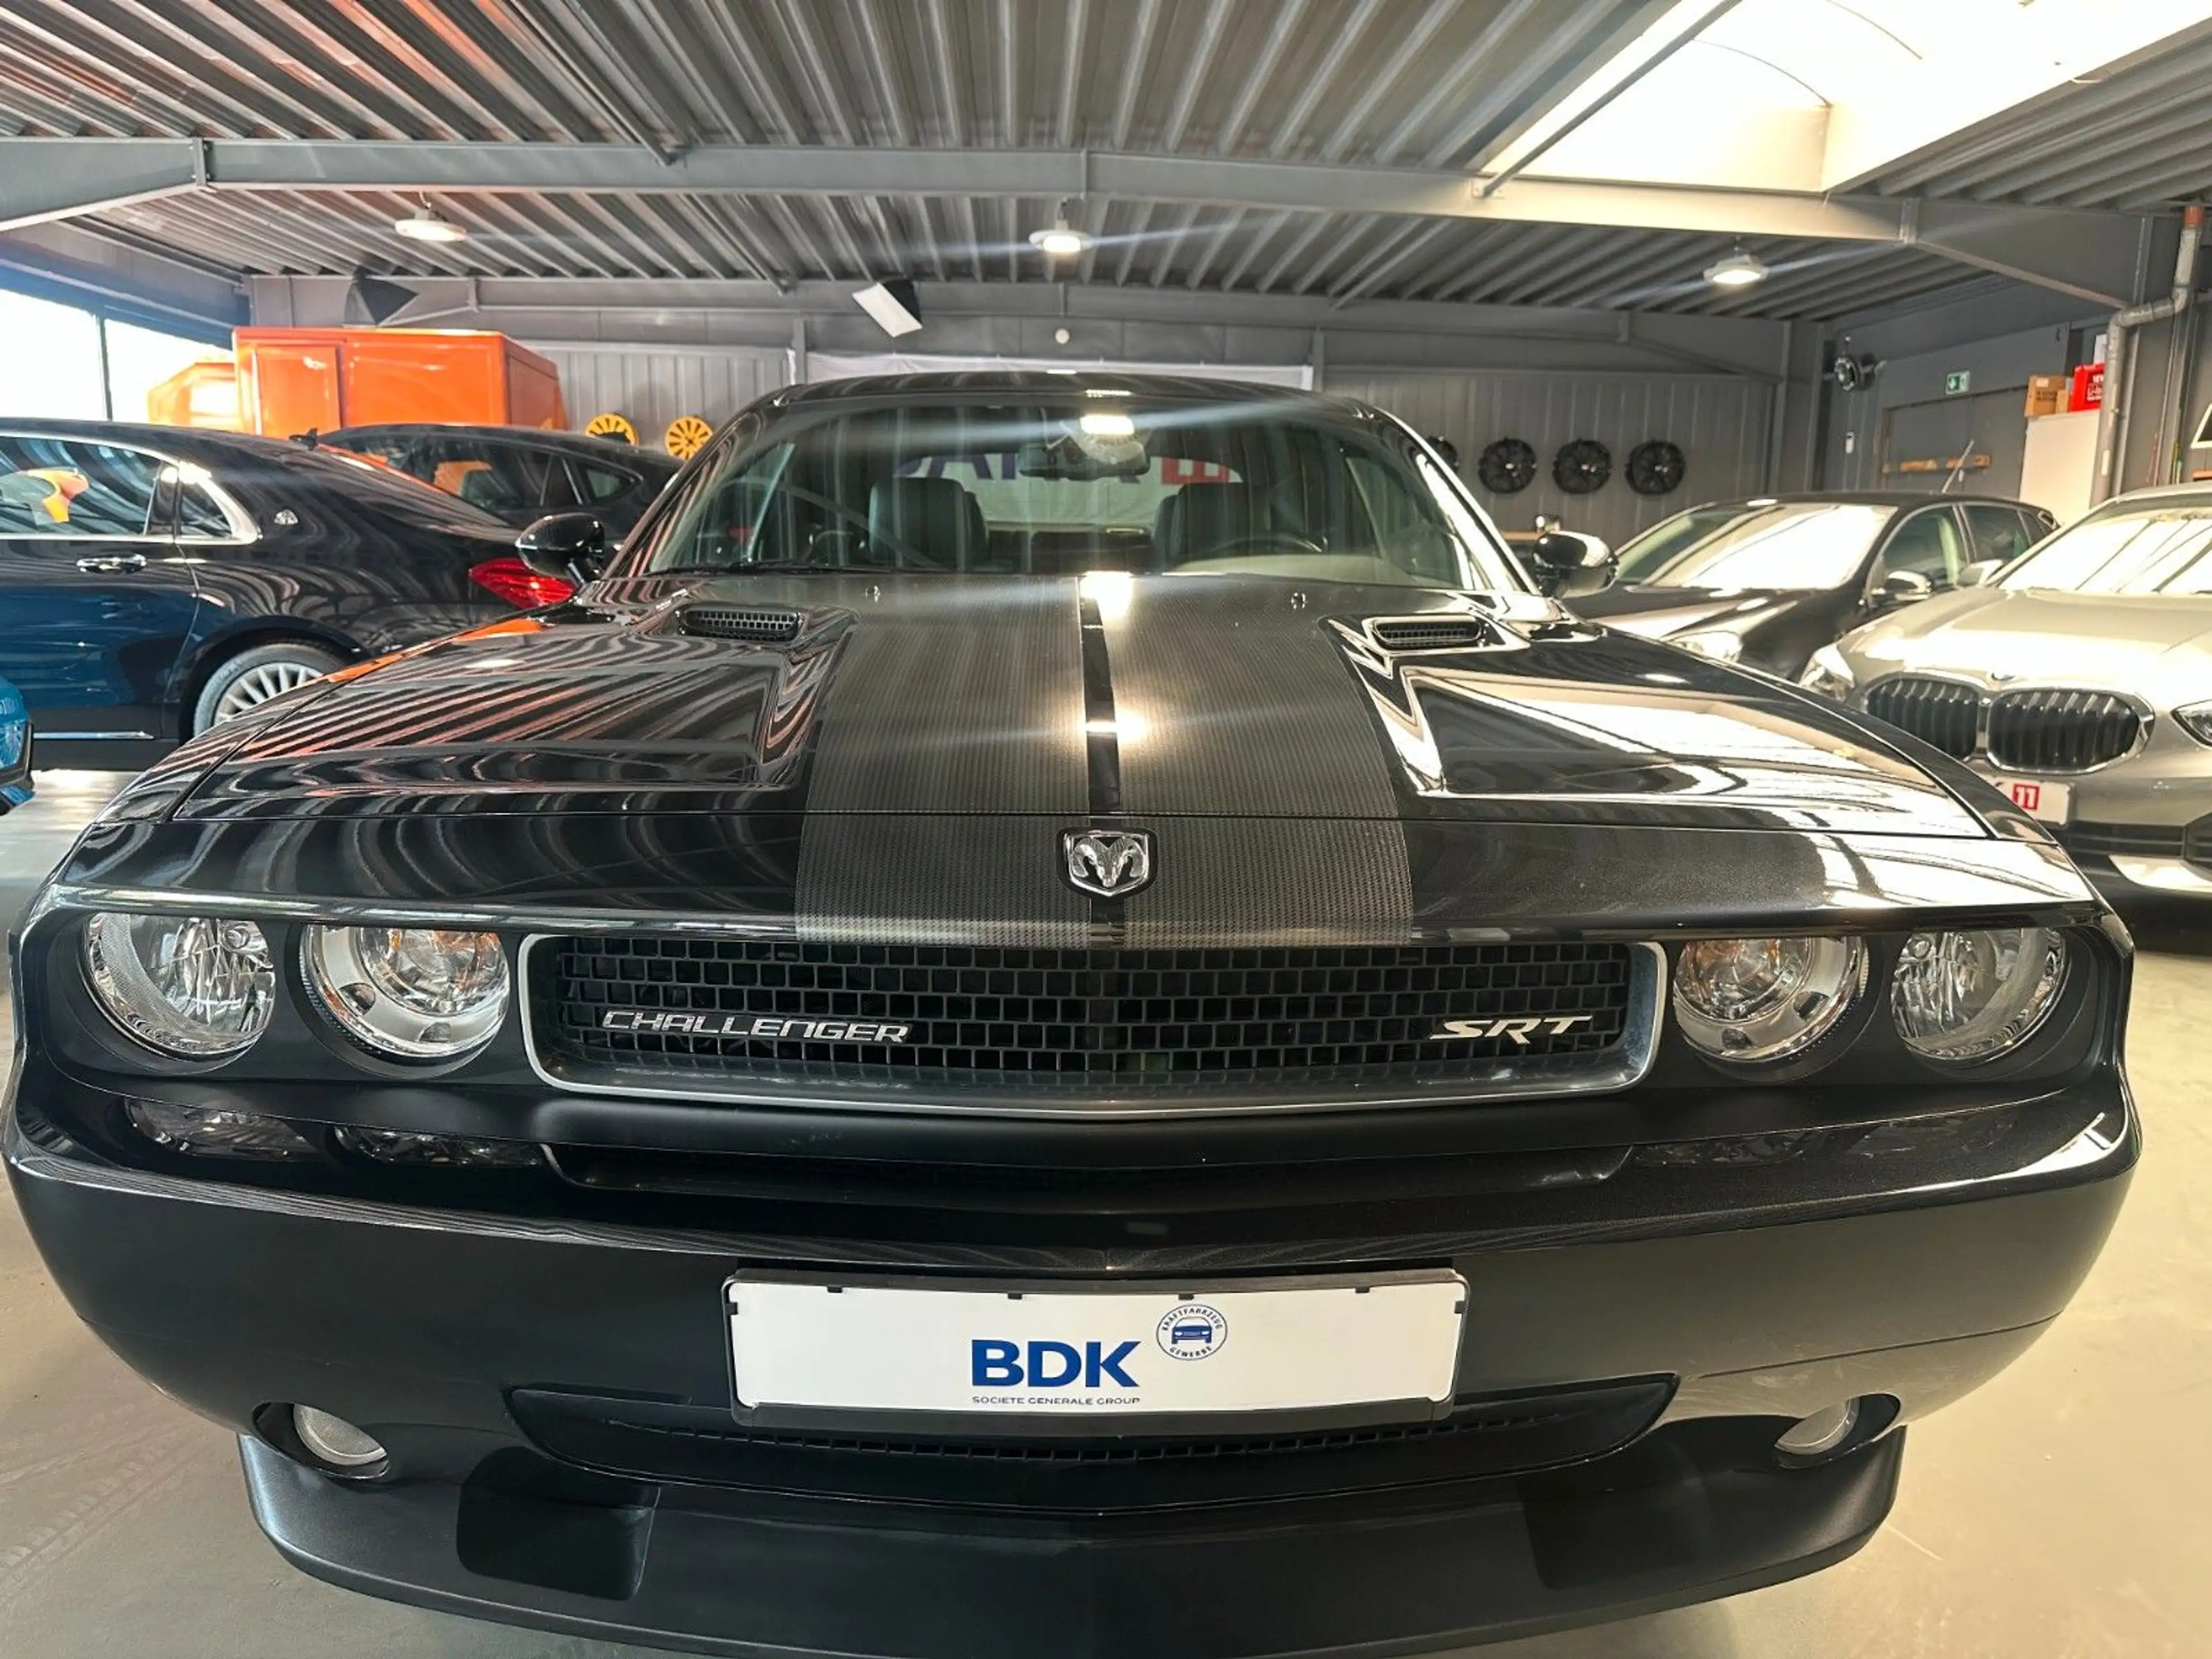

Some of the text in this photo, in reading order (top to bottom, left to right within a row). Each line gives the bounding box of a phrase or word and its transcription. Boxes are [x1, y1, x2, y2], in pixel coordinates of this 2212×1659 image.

[602, 1010, 910, 1043] CHALLENGER
[1429, 1015, 1593, 1045] SRT
[972, 1339, 1142, 1387] BDK
[1169, 1345, 1212, 1357] GEWERBE
[972, 1396, 1024, 1404] SOCIETE
[1028, 1397, 1093, 1406] GENERALE
